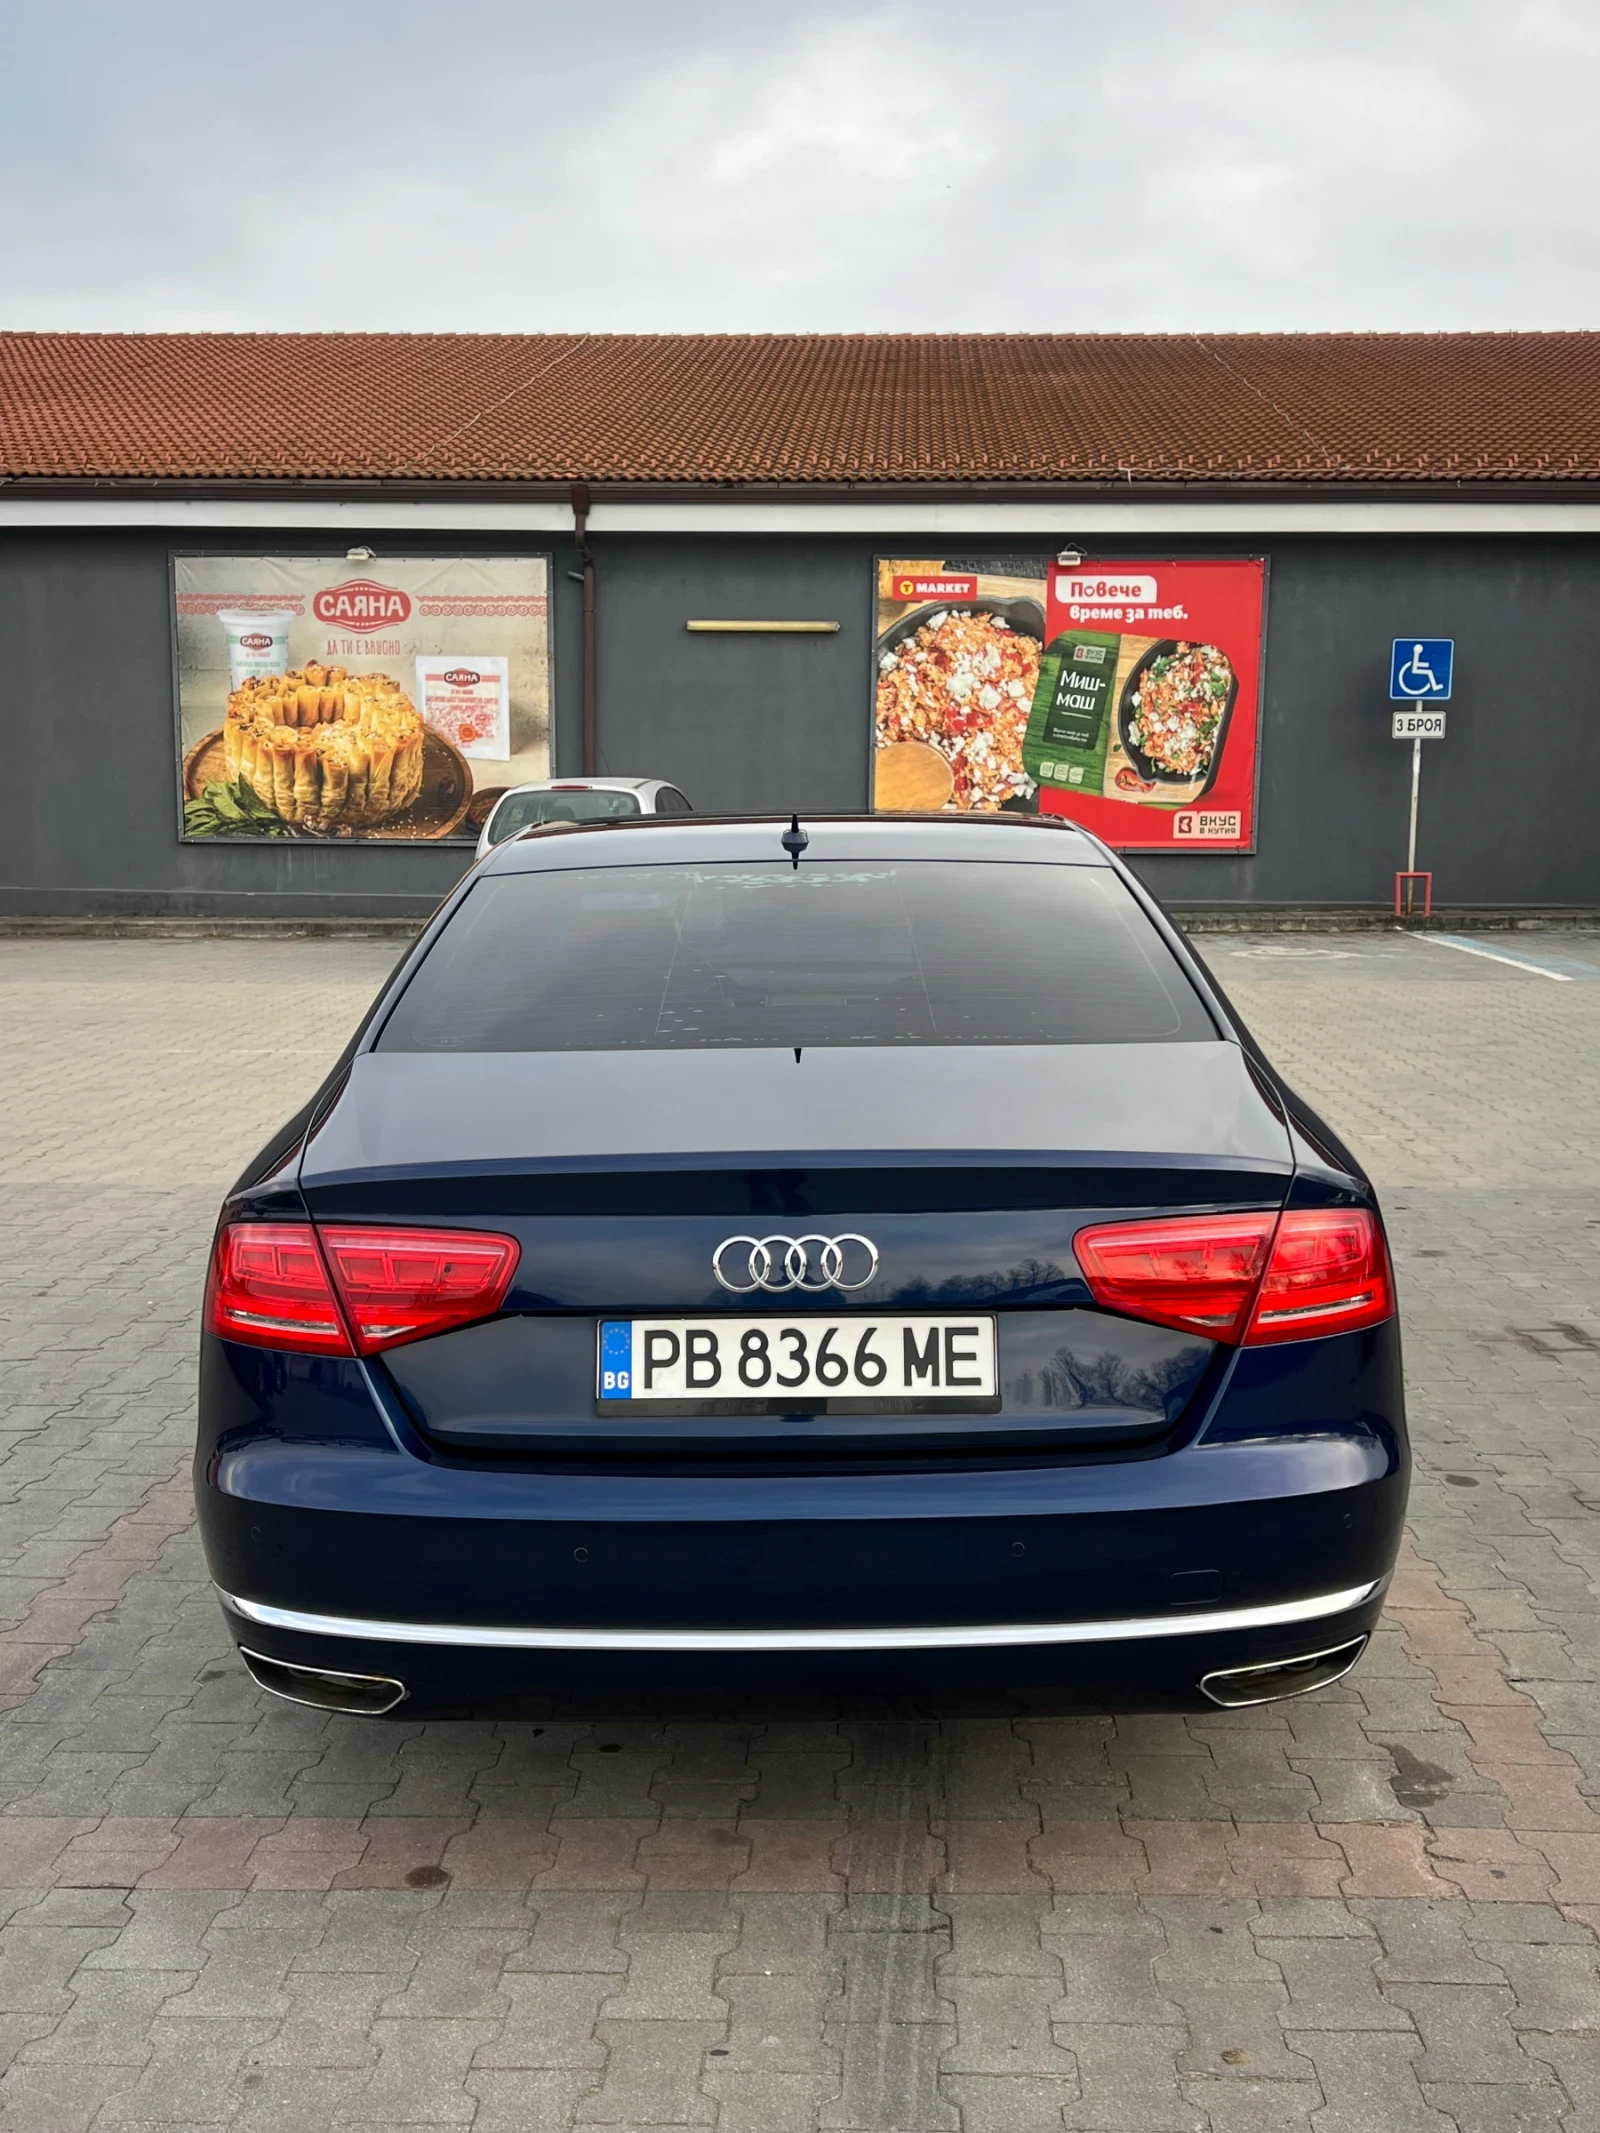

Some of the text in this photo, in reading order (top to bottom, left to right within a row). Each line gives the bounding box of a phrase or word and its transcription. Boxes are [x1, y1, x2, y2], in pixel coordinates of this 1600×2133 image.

[916, 582, 970, 593] MARKET
[1071, 581, 1142, 598] Повече
[319, 595, 405, 617] САЯНА
[1069, 604, 1189, 623] време за теб.
[241, 637, 271, 646] САЯНА
[341, 640, 353, 655] ТИ
[355, 640, 363, 655] Е
[445, 673, 478, 682] САЯНА
[1060, 670, 1106, 691] Миш-
[1056, 692, 1096, 710] маш
[1396, 718, 1442, 731] 3 БРОЯ
[1200, 816, 1237, 826] ВКУС
[1208, 827, 1236, 835] КУТИЯ
[603, 1326, 982, 1390] BG PB 8366 ME
